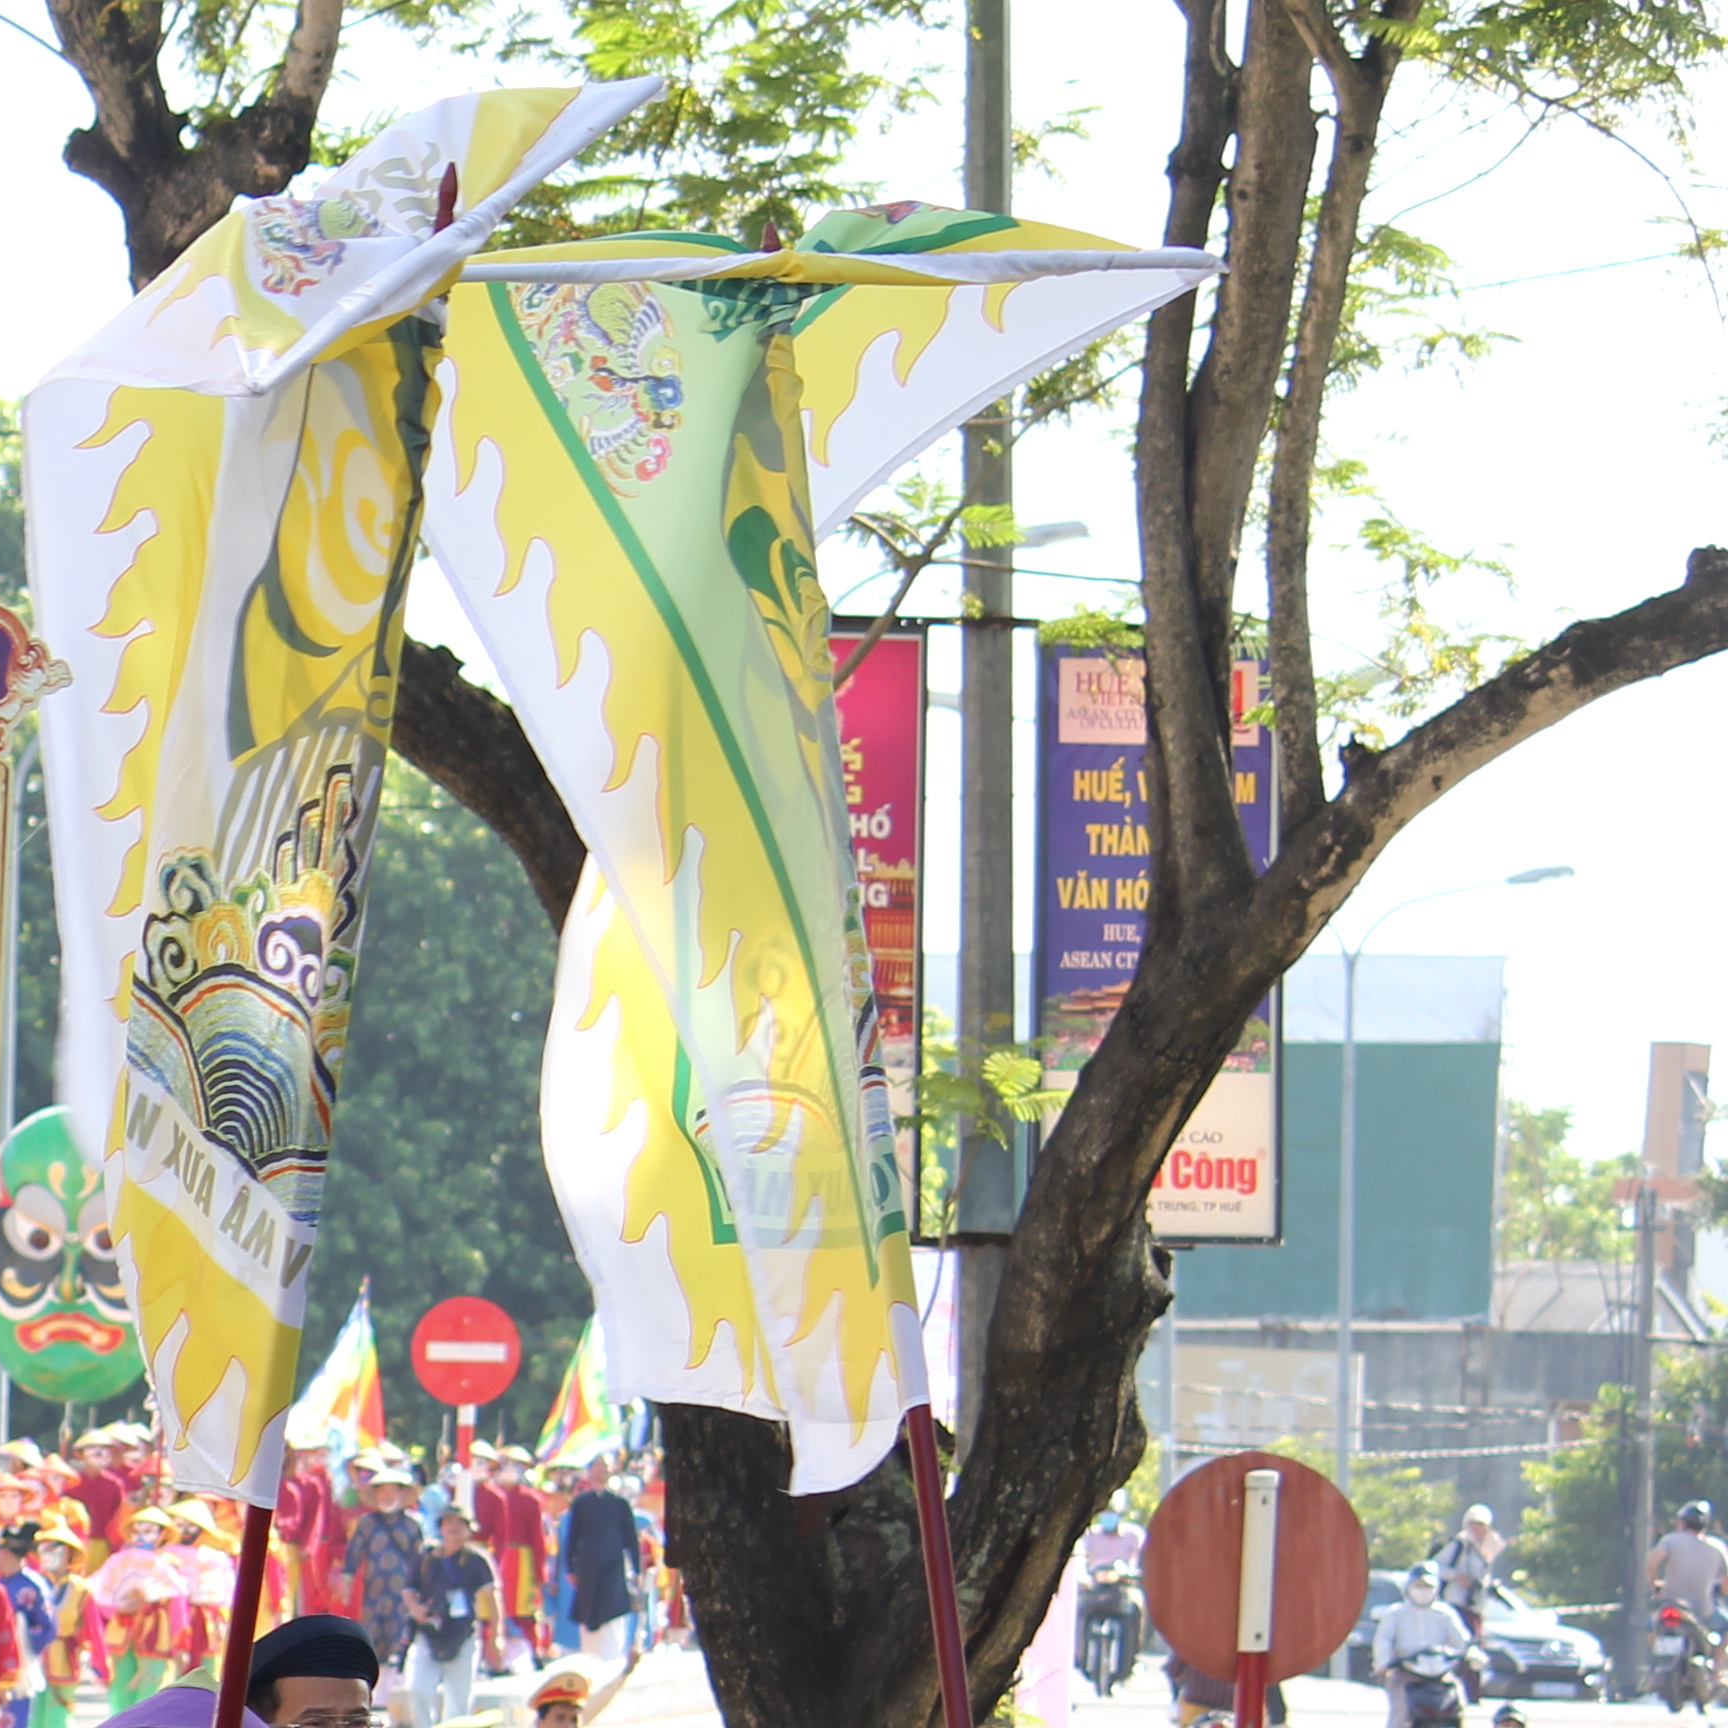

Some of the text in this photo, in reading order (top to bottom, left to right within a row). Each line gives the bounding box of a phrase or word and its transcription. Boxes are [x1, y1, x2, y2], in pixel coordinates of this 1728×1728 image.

[1073, 756, 1133, 808] HUẾ,
[1057, 870, 1109, 909] VĂN
[1059, 951, 1113, 969] ASEAN
[161, 1120, 217, 1218] XƯA
[219, 1184, 276, 1270] ÂM
[1170, 1150, 1257, 1195] Công
